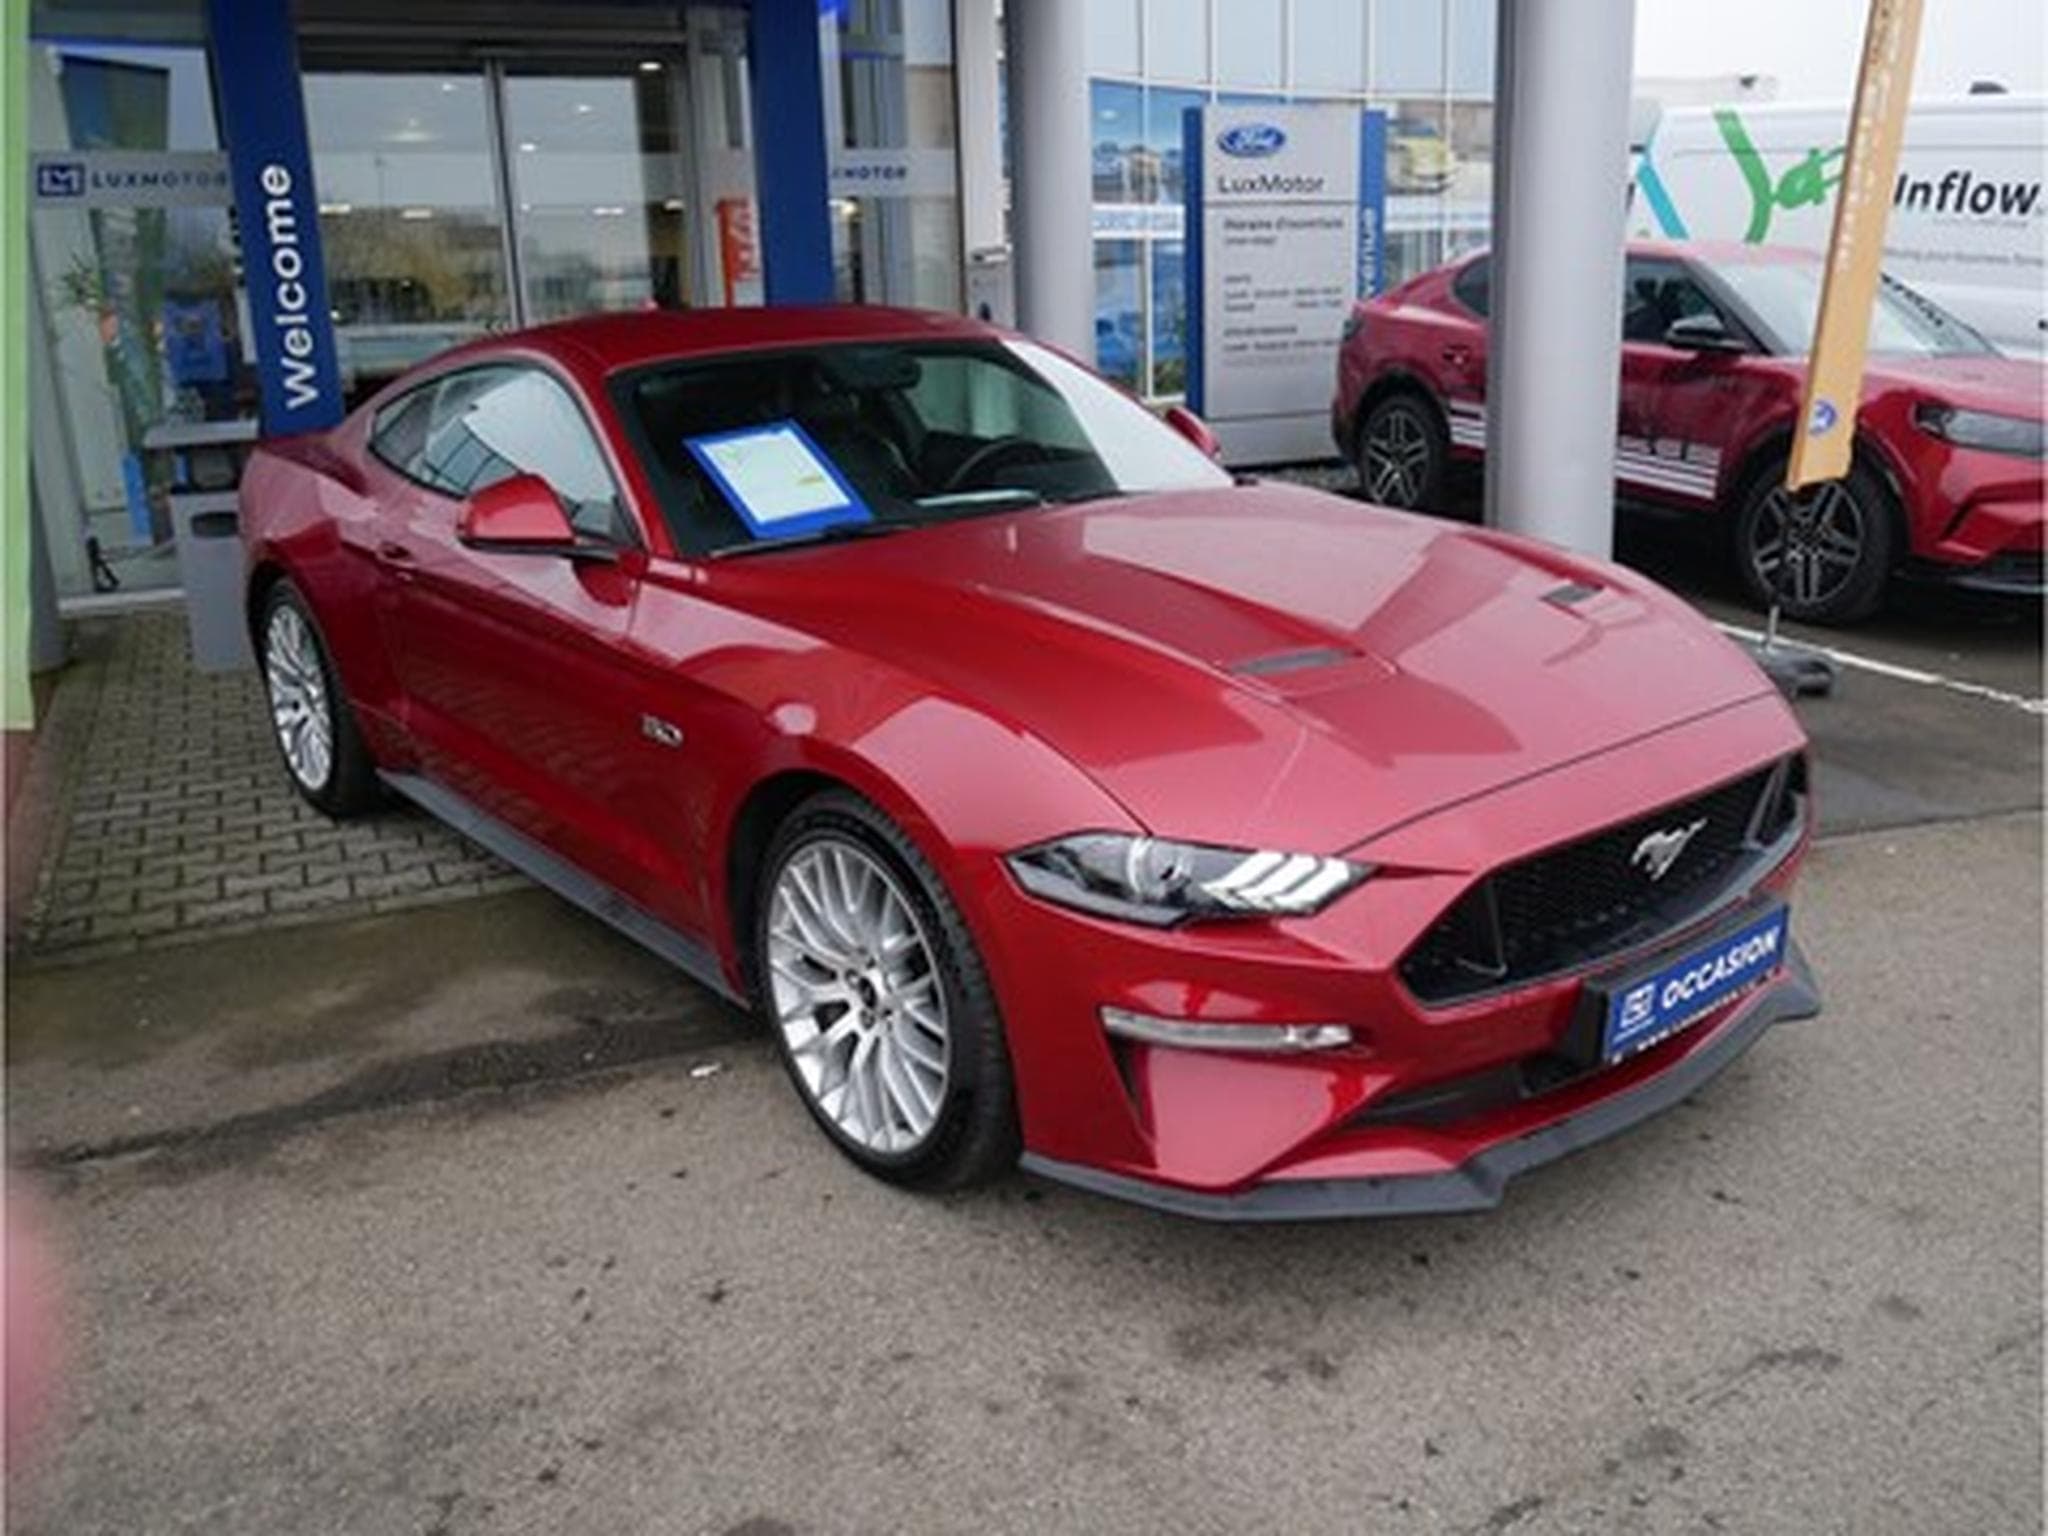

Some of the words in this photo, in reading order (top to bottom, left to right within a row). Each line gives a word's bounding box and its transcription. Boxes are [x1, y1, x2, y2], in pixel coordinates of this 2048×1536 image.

[91, 171, 227, 189] LUXMOTOR
[1217, 174, 1325, 194] LuxMotor
[1893, 170, 2041, 216] Inflow
[260, 164, 319, 410] Welcome
[1661, 925, 1781, 1010] OCCASION
